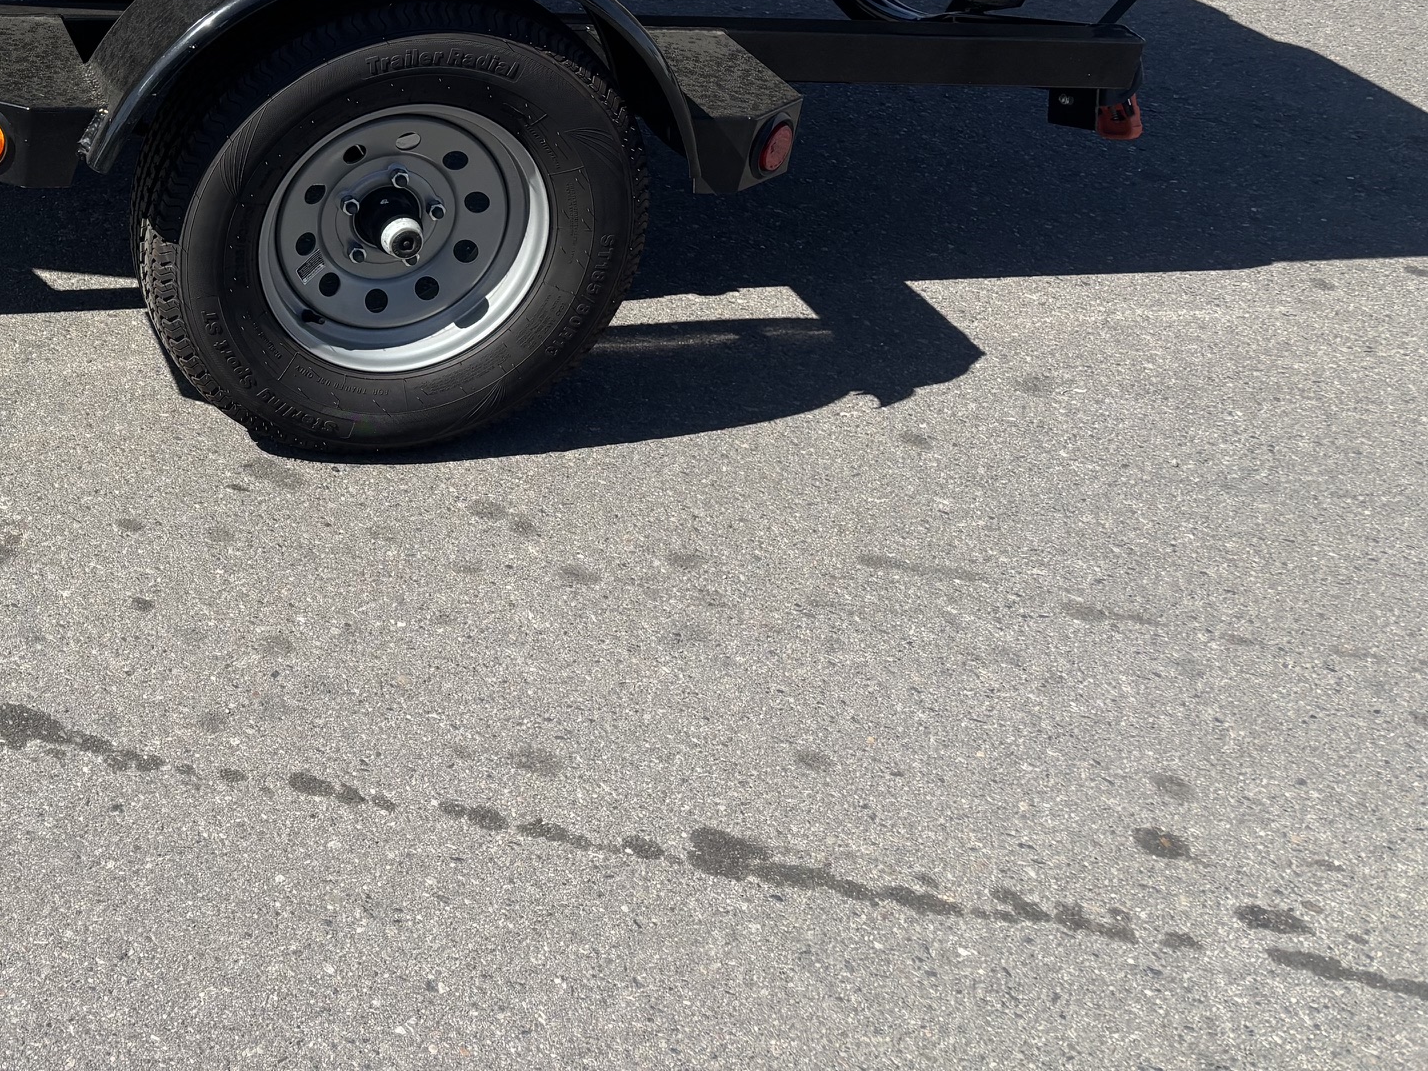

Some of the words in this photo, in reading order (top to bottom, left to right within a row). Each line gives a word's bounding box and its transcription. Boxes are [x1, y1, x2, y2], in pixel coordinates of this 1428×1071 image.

[365, 48, 445, 77] Trailer
[446, 46, 521, 79] Radial
[200, 310, 224, 336] ST
[212, 338, 259, 390] Sport
